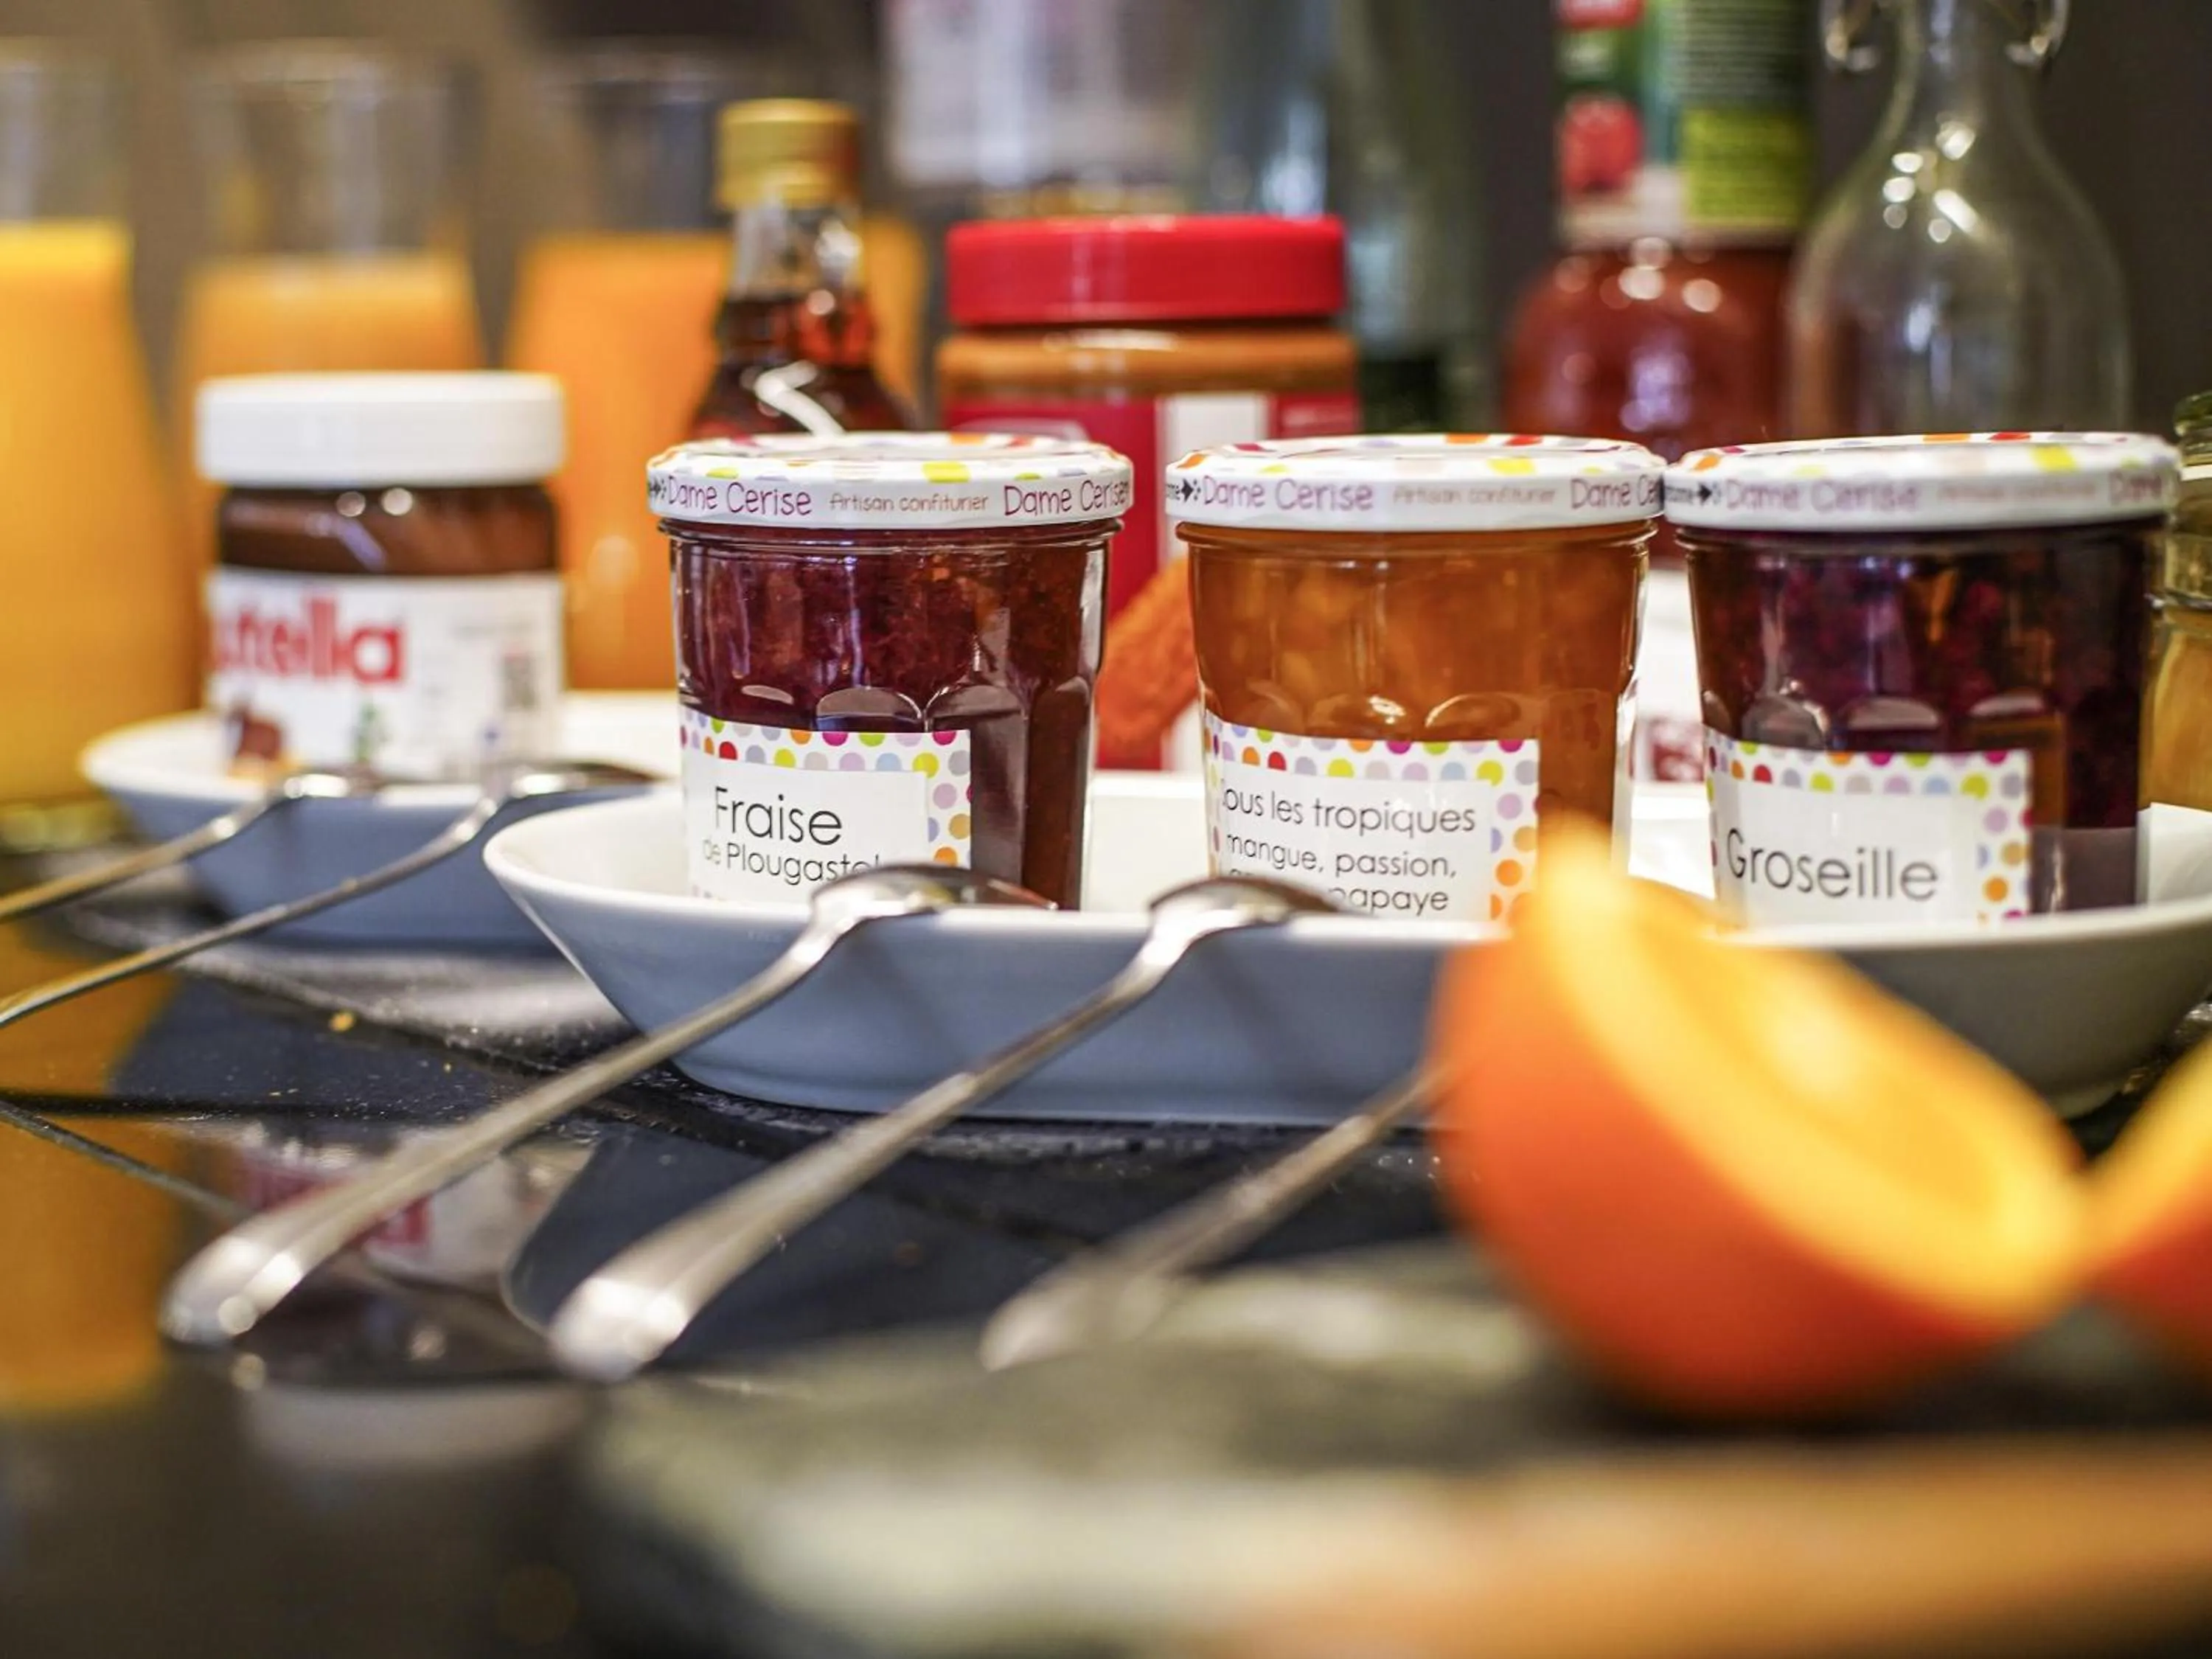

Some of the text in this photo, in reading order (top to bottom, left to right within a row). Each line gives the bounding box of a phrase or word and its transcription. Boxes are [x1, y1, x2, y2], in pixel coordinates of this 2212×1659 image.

[668, 475, 718, 510] Dame
[726, 481, 812, 516] Cerise
[829, 492, 894, 512] Artisan
[1004, 484, 1072, 517] Dame
[1080, 479, 1125, 511] Cerise
[1203, 474, 1265, 509] Dame
[1275, 478, 1374, 511] Cerise
[1570, 477, 1631, 509] Dame
[714, 785, 843, 846] Fraise
[1270, 790, 1304, 825] les
[1312, 797, 1476, 839] tropiques
[703, 838, 721, 866] de
[1335, 850, 1457, 878] passion,
[1725, 827, 1939, 902] Groseille
